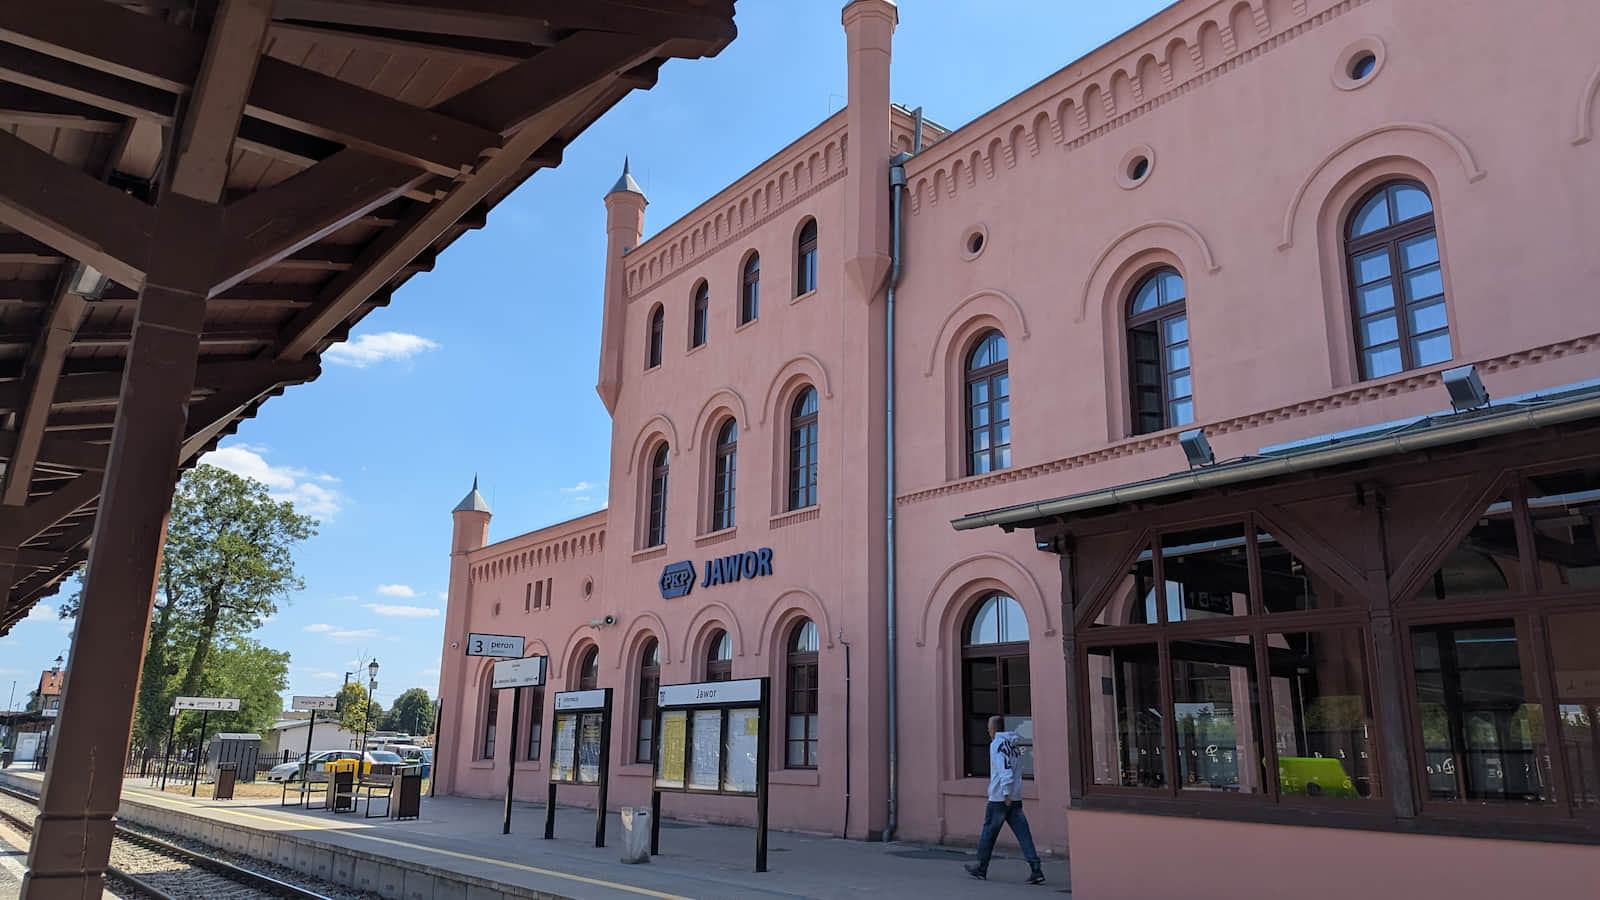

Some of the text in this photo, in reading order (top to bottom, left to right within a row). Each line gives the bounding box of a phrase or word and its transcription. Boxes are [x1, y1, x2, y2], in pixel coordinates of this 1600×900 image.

[663, 547, 773, 590] PKP JAWOR
[474, 640, 514, 653] 3 peron
[696, 688, 717, 699] Jawor
